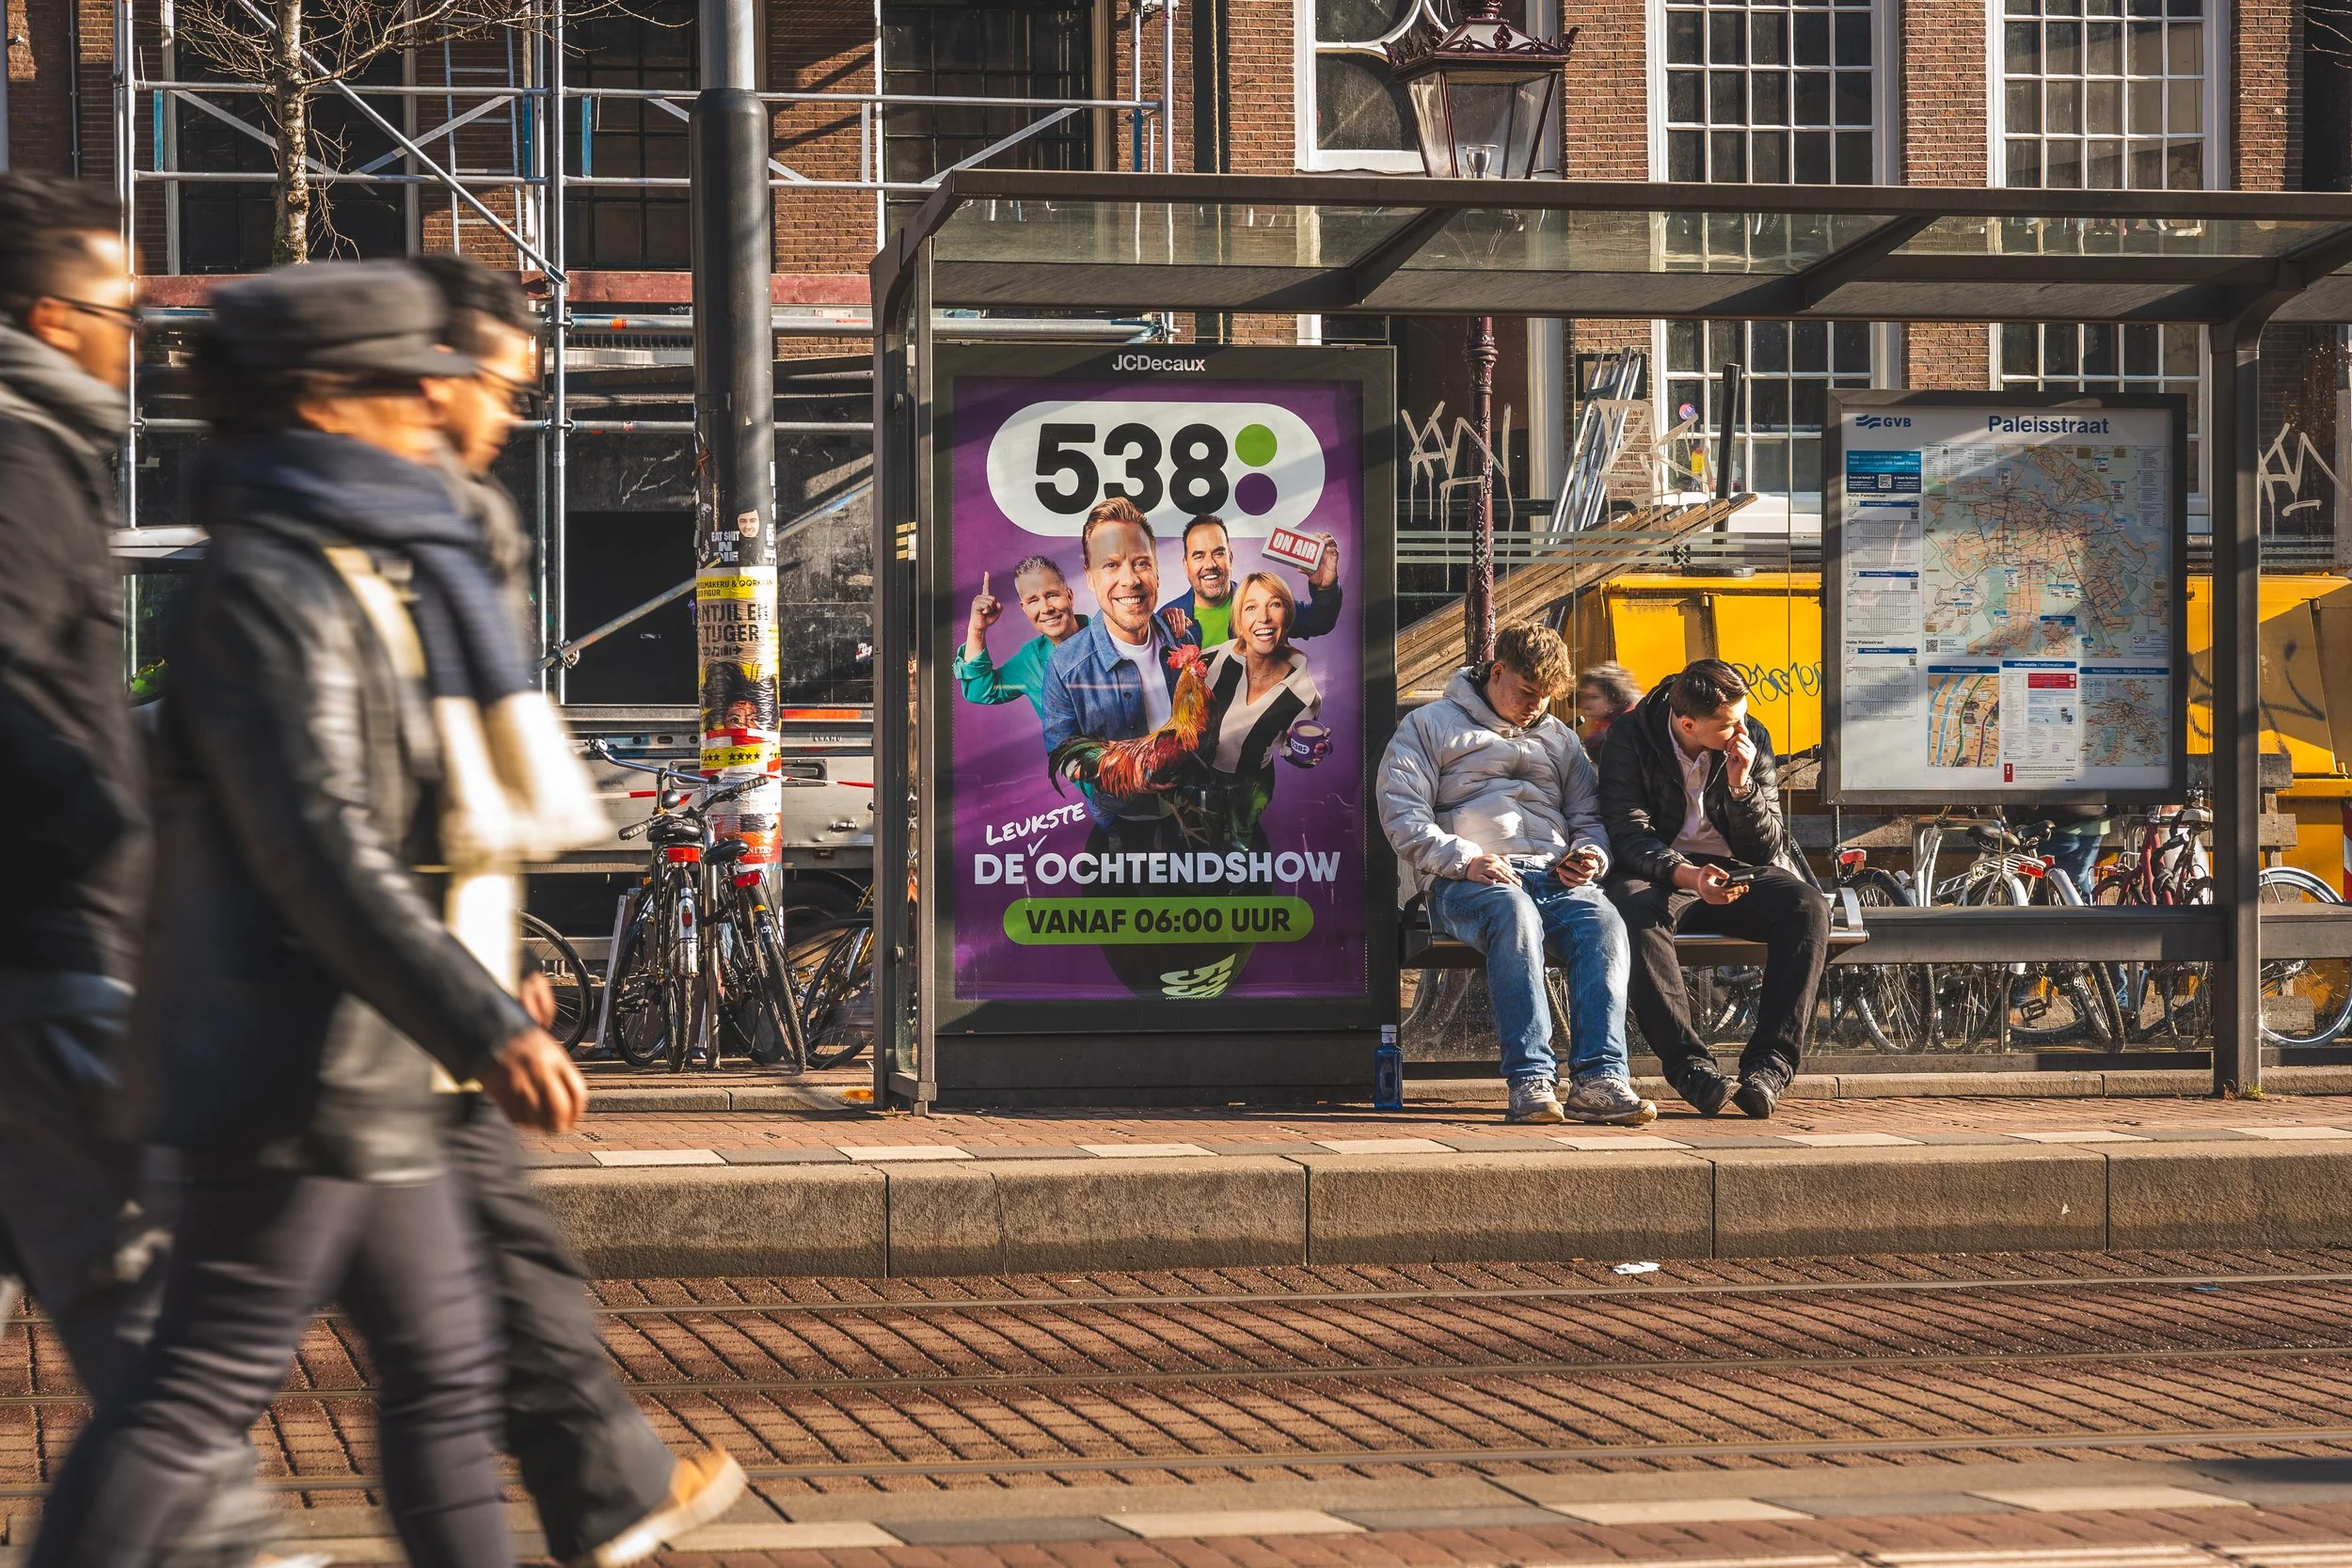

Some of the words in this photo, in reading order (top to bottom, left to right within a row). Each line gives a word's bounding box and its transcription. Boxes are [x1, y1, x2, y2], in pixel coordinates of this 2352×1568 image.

[1112, 355, 1206, 372] JCDecaux
[1883, 418, 1912, 427] GVB
[1988, 416, 2110, 435] Paleisstraat
[1034, 422, 1230, 515] 538
[711, 531, 723, 543] EAT
[1273, 532, 1295, 552] ON
[1291, 539, 1317, 561] AIR
[718, 542, 733, 552] N
[699, 603, 742, 622] NTJIL
[985, 801, 1087, 847] LEUKSTE
[974, 852, 1025, 885] DE
[1035, 851, 1342, 885] OCHTENDSHOW
[1025, 909, 1127, 934] VANAF
[1134, 907, 1223, 933] 06:00
[1232, 907, 1292, 932] UUR
